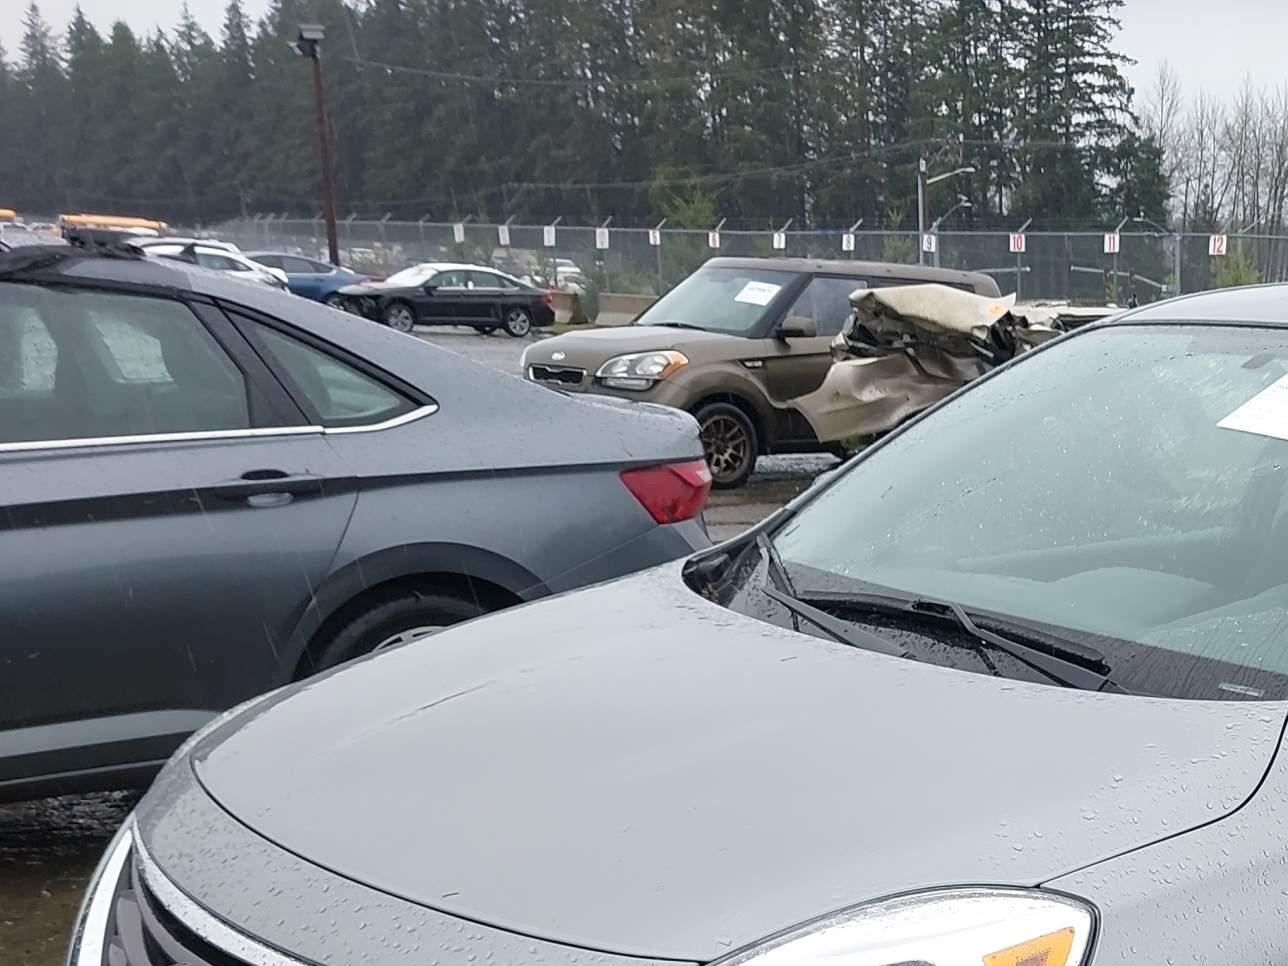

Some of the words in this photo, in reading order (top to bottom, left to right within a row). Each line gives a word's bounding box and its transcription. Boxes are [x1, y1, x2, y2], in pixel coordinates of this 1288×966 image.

[926, 235, 932, 250] 9
[1012, 236, 1023, 250] 10
[1107, 235, 1115, 251] 11
[1212, 237, 1224, 253] 12
